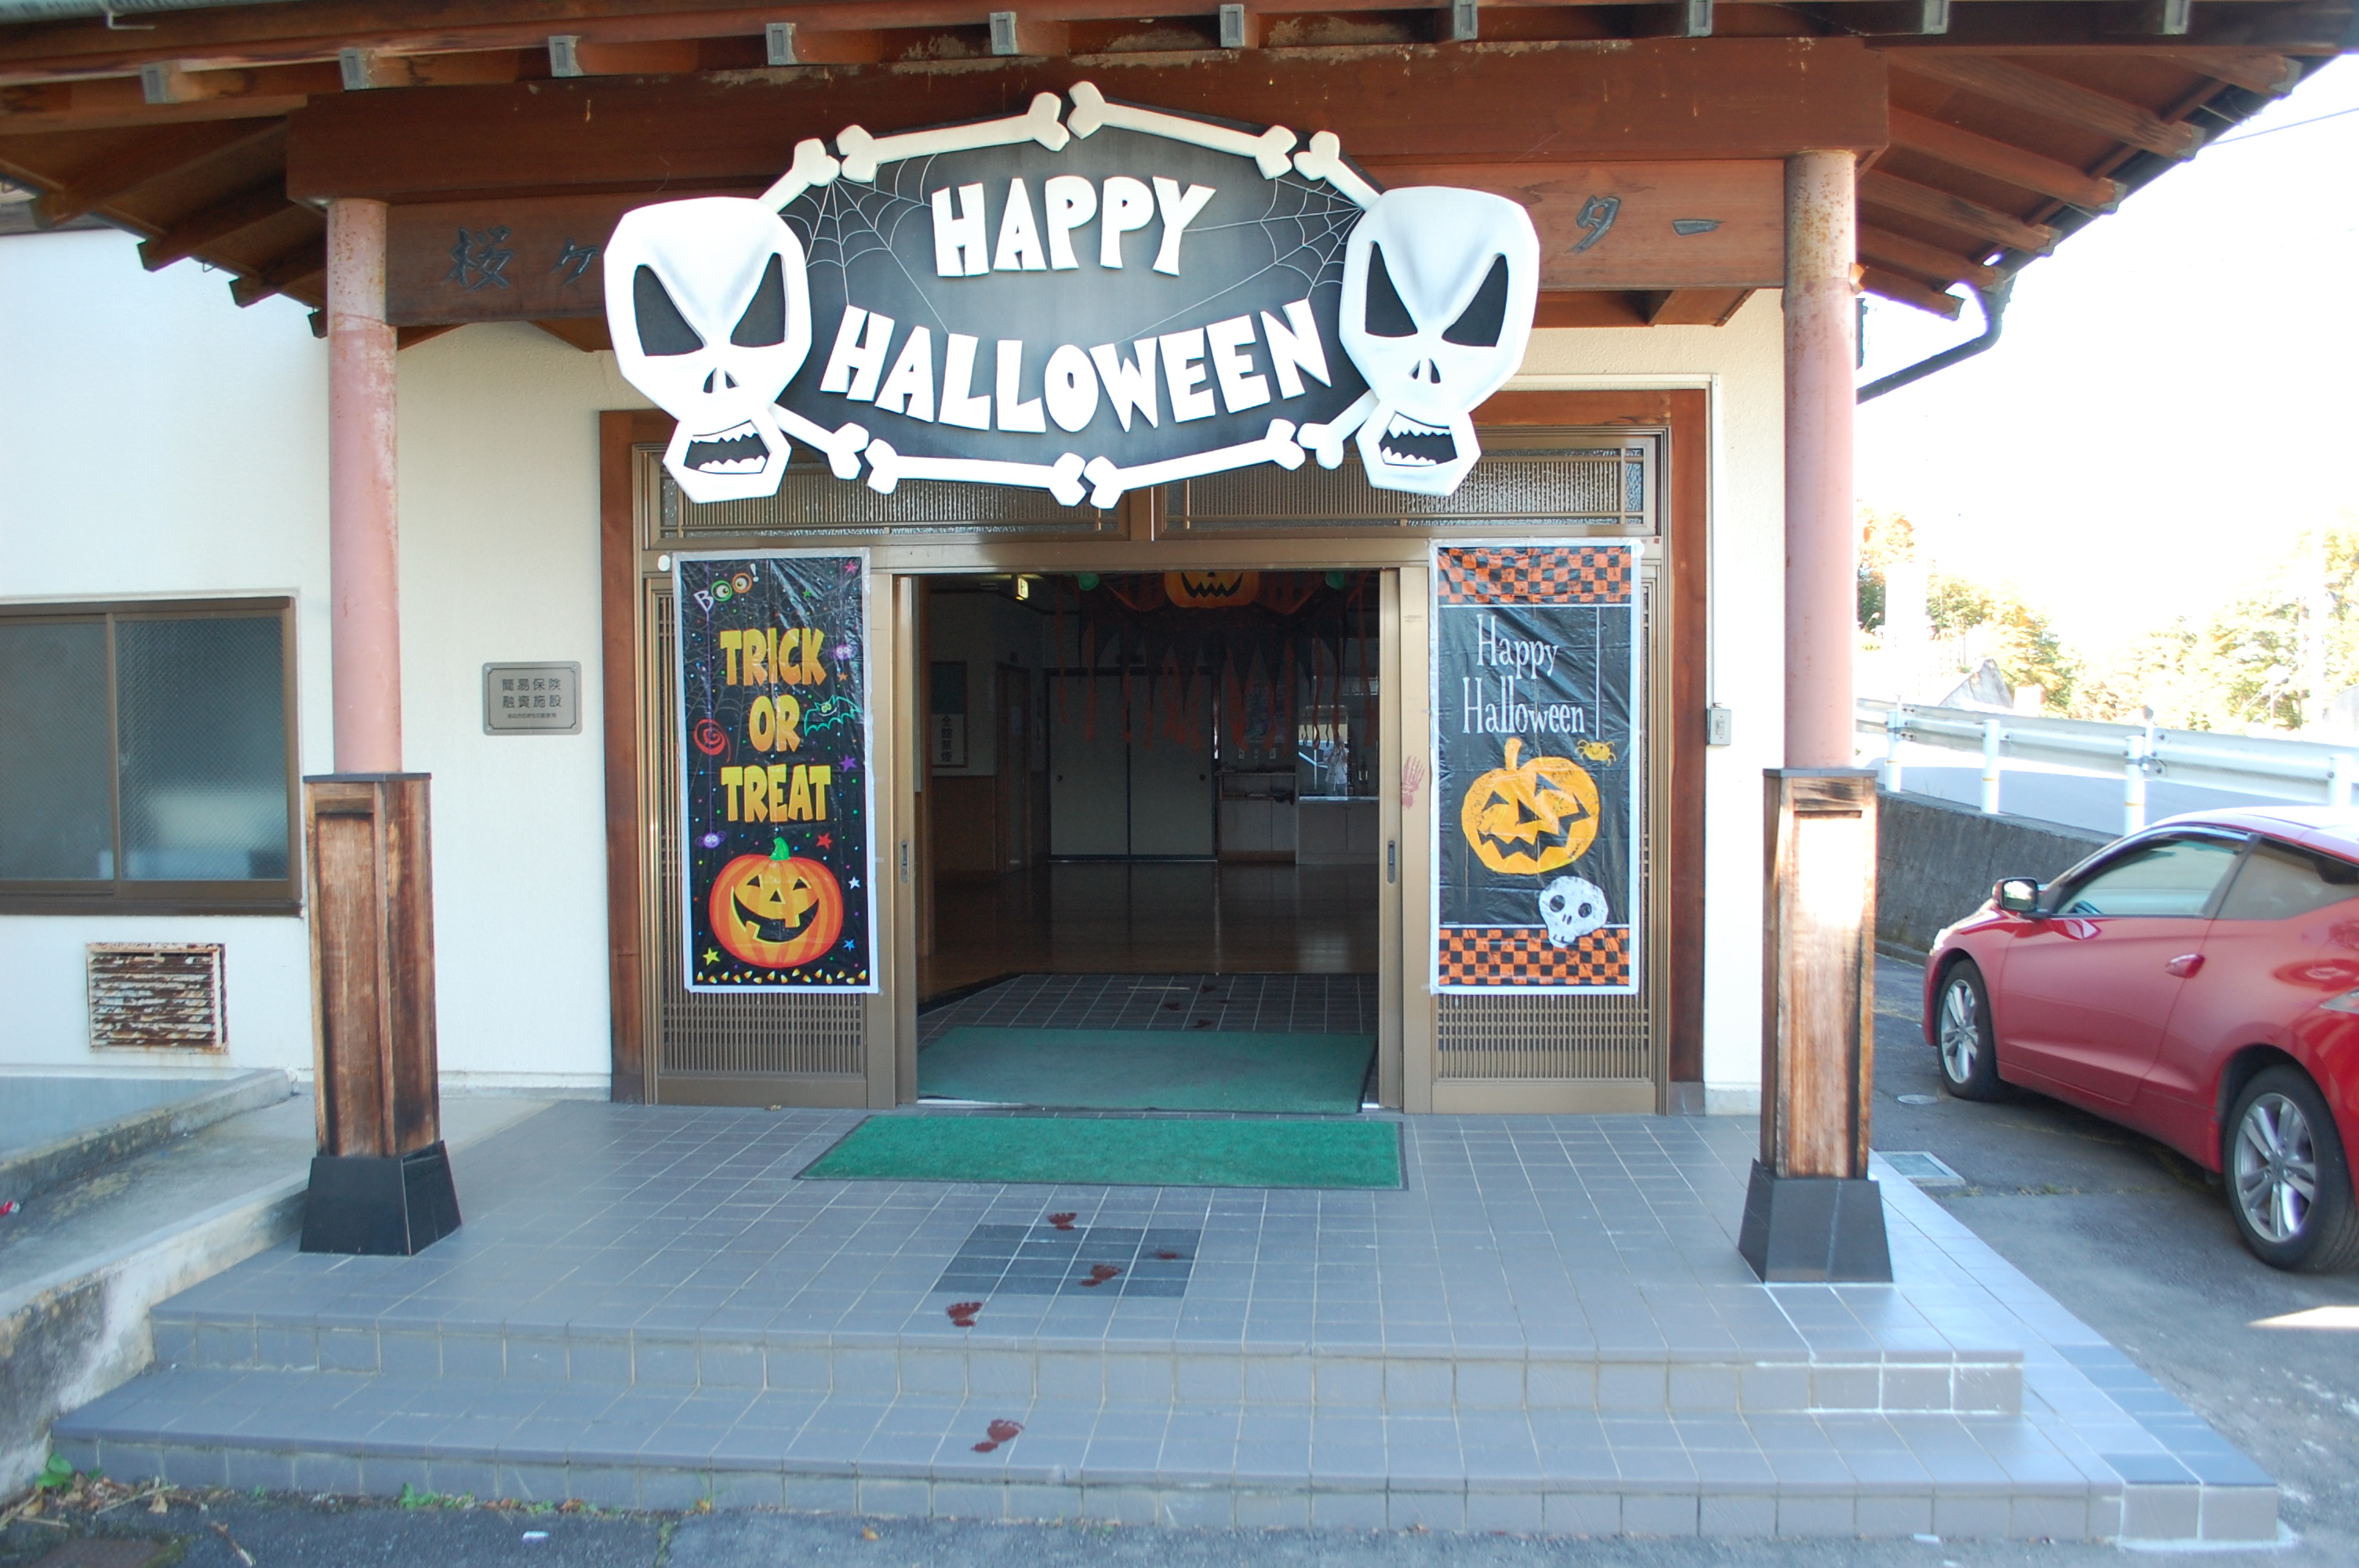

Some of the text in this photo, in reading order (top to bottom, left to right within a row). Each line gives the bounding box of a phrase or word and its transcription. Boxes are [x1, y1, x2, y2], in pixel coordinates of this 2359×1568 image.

[931, 175, 1217, 277] HAPPY
[820, 298, 1332, 434] HALLOWEEN
[719, 627, 827, 686] TRICK
[1477, 614, 1559, 681] Happy
[749, 694, 801, 753] OR
[1462, 675, 1586, 734] Halloween
[720, 763, 831, 823] TREAT
